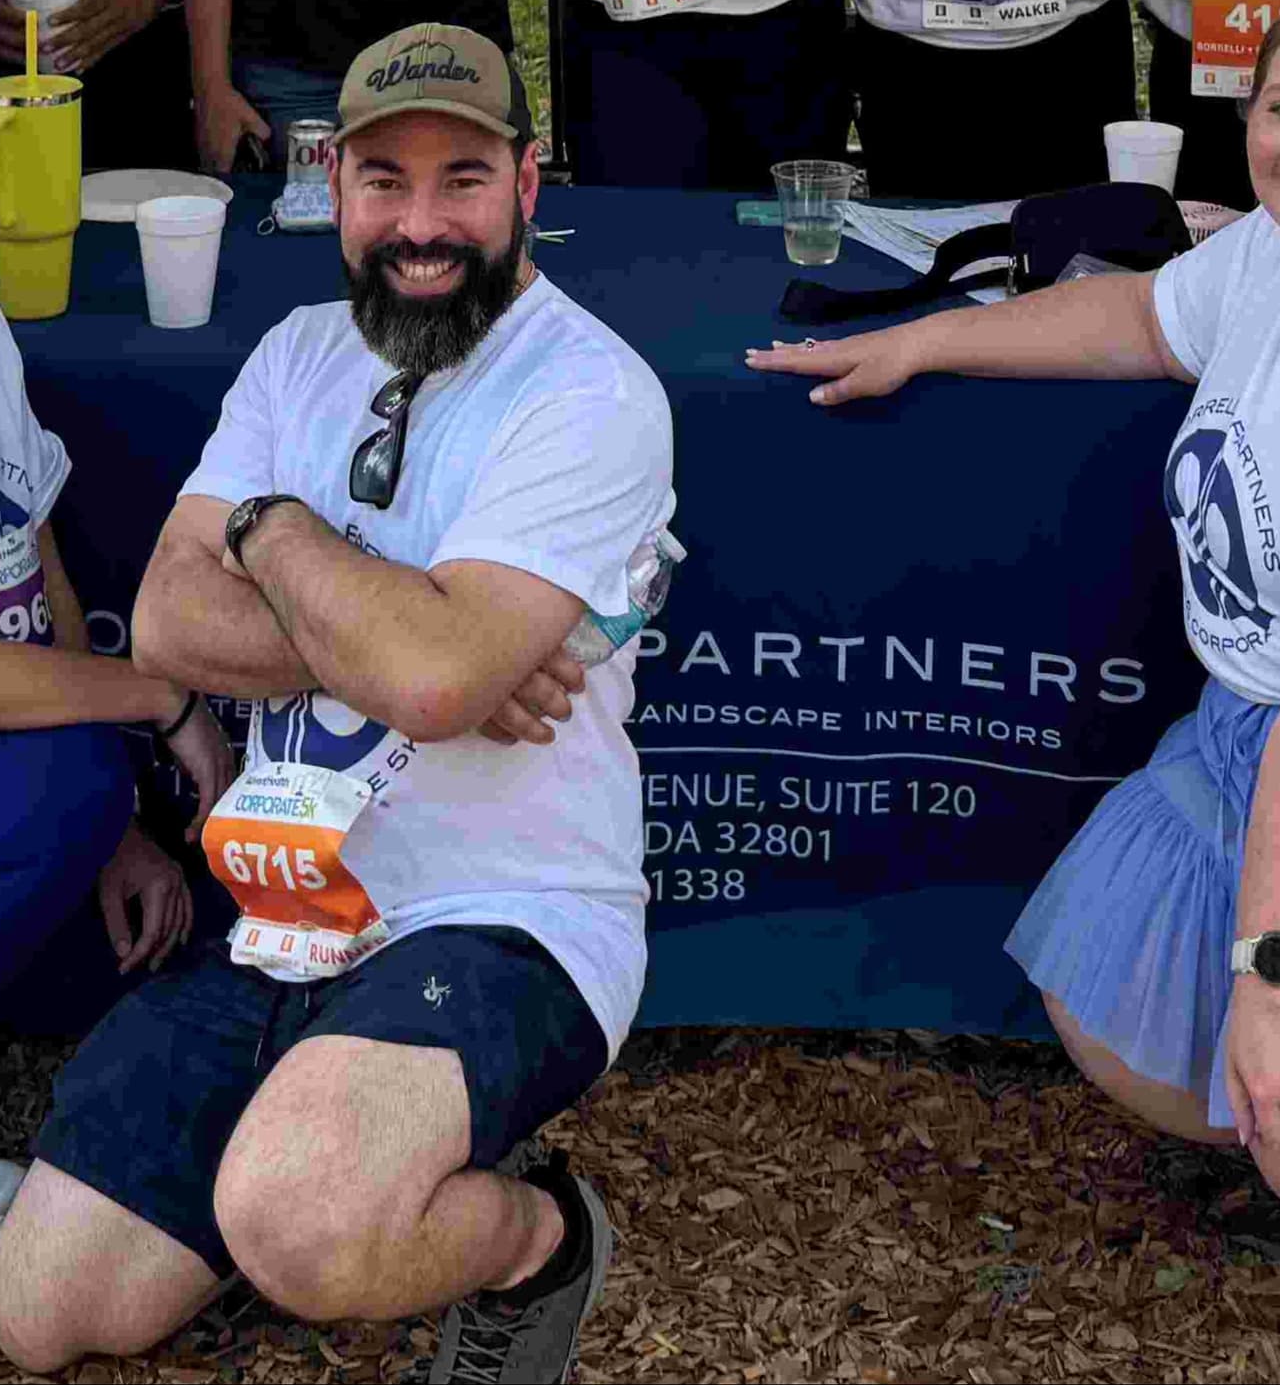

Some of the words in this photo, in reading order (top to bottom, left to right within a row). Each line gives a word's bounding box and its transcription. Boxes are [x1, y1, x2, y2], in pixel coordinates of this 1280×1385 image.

[998, 0, 1061, 21] WALKER
[366, 54, 481, 93] Wander
[634, 628, 1146, 704] PARTNERS
[865, 710, 1063, 749] INTERIORS
[641, 773, 766, 812] ENUE,
[779, 776, 892, 814] SUITE
[907, 782, 977, 817] 120
[644, 821, 702, 855] DA
[714, 822, 832, 862] 32801
[222, 839, 328, 891] 6715
[651, 868, 746, 901] 1338
